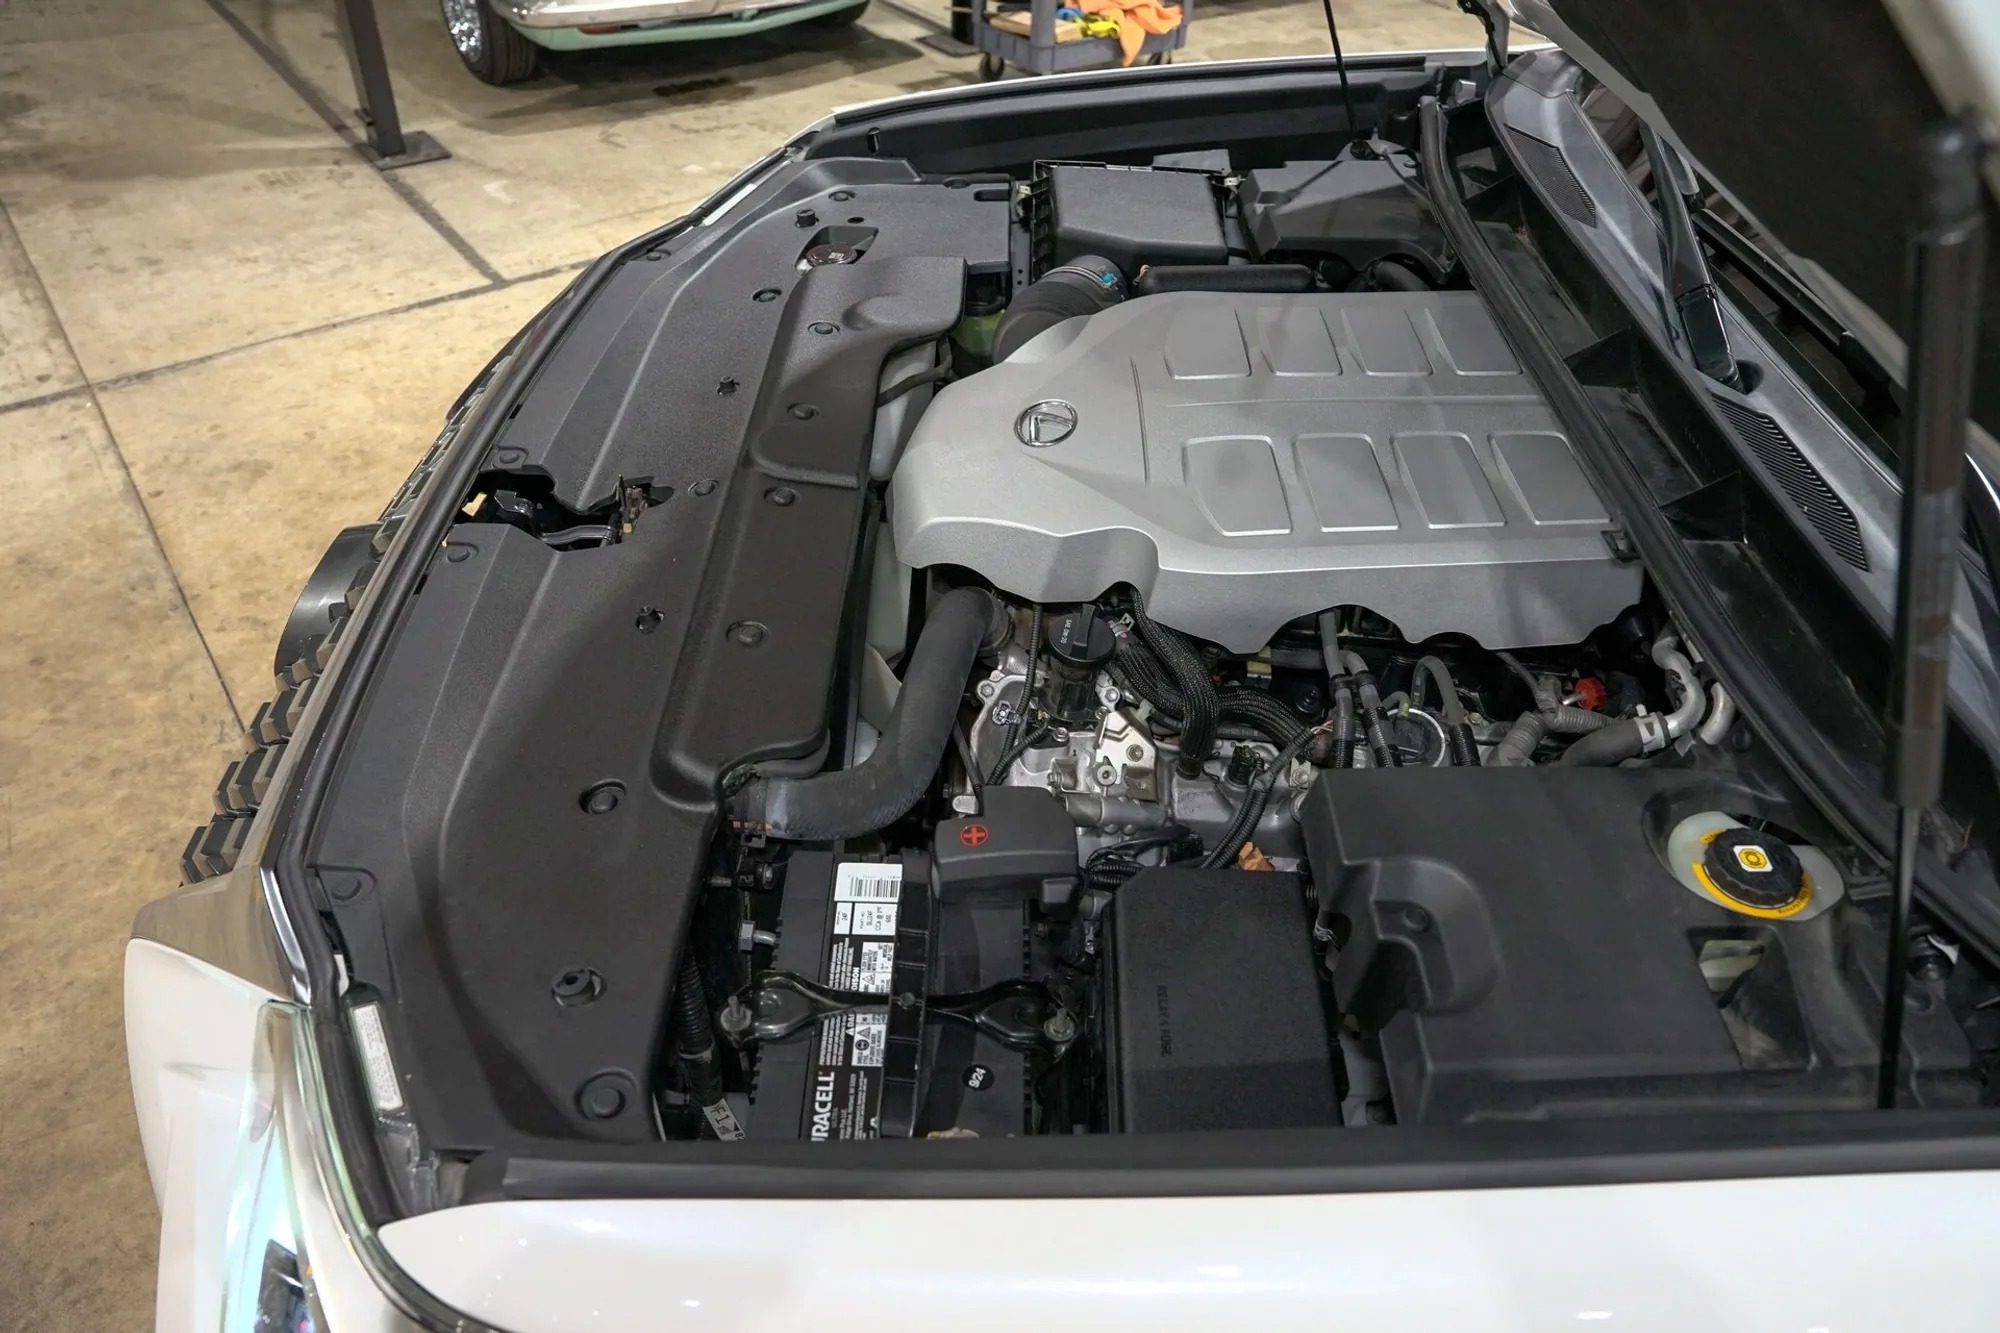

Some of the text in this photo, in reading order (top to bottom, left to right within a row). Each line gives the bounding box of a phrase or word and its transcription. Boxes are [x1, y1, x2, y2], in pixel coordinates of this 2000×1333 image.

[850, 966, 860, 991] OISON
[1161, 1029, 1173, 1057] FUSE
[968, 1067, 986, 1089] 9/24
